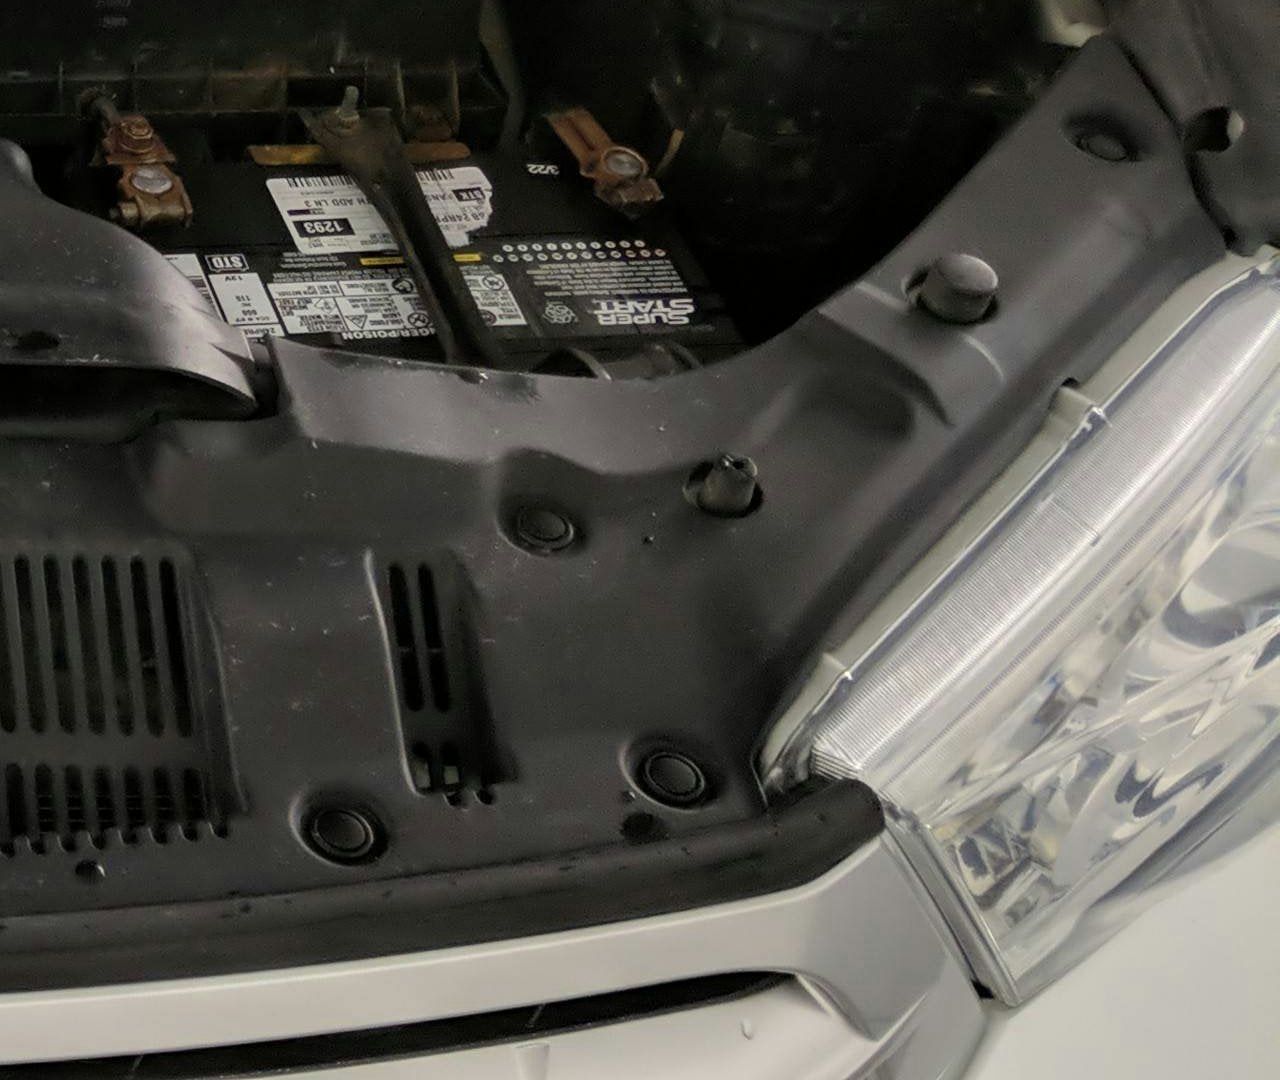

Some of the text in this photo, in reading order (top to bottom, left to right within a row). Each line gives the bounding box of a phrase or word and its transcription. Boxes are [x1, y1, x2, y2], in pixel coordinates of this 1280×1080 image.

[526, 164, 560, 175] 3/22
[304, 221, 344, 233] 1293
[211, 256, 244, 269] STD
[596, 312, 690, 325] SUPER
[341, 328, 436, 340] GER/POISON
